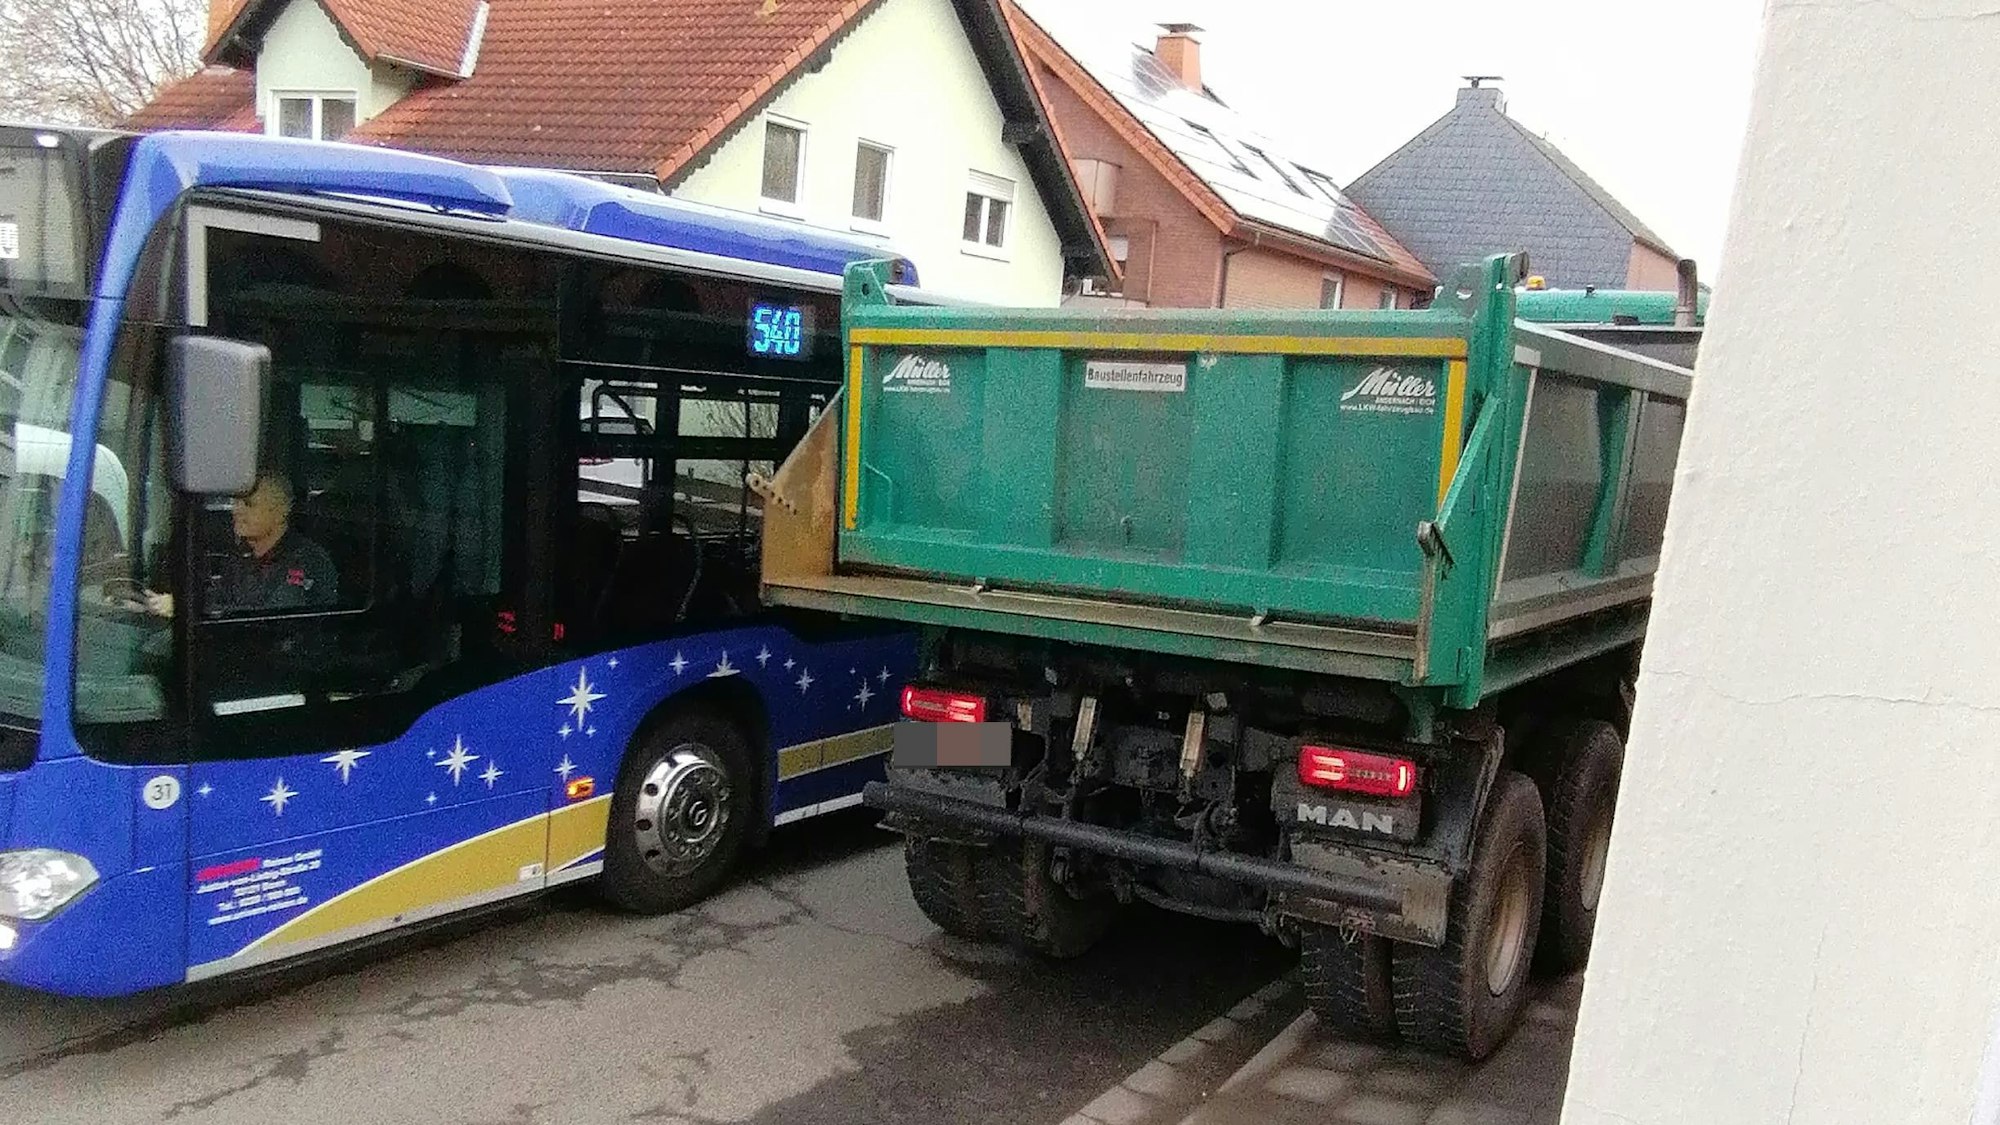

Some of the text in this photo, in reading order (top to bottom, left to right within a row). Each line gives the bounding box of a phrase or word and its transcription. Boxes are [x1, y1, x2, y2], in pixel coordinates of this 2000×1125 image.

[754, 309, 800, 354] 540
[882, 353, 950, 384] Müller
[1087, 368, 1183, 387] Baustellenfahrzeug
[1340, 366, 1436, 402] Müller
[151, 783, 172, 801] 31
[1297, 803, 1393, 834] MAN
